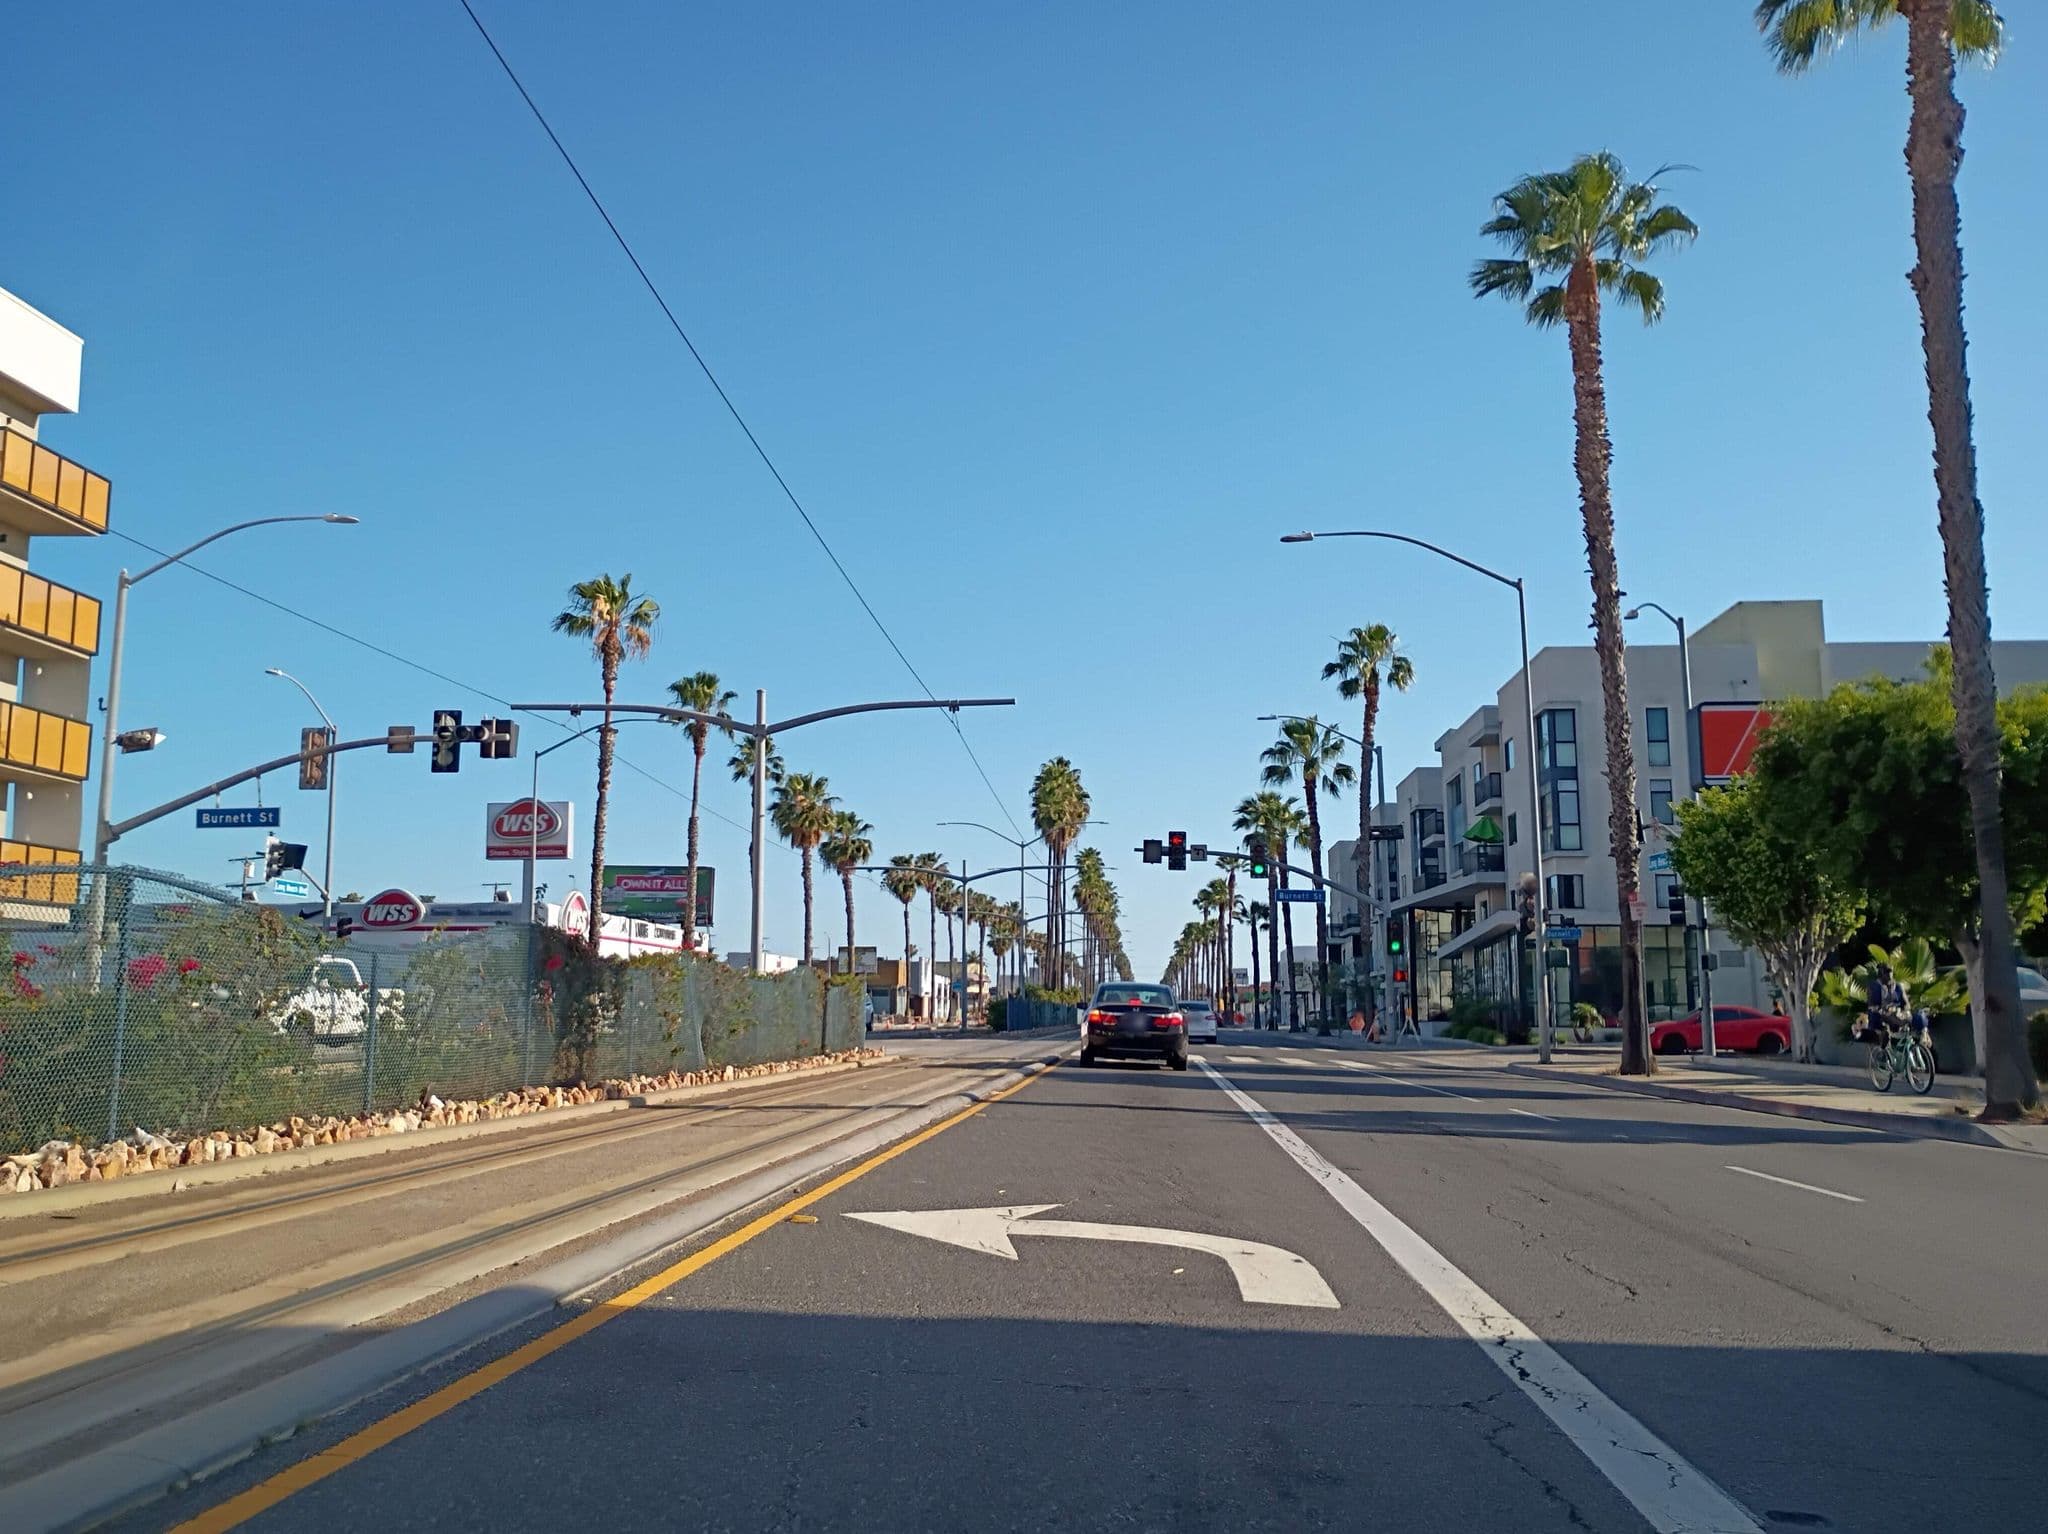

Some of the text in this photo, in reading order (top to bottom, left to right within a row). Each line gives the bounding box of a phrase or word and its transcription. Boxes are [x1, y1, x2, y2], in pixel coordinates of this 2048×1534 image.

[202, 812, 274, 824] Burnett St
[502, 813, 549, 832] WSS
[621, 879, 687, 890] OWN IT ALL!
[1279, 892, 1310, 900] Burnett
[366, 904, 416, 922] WSS
